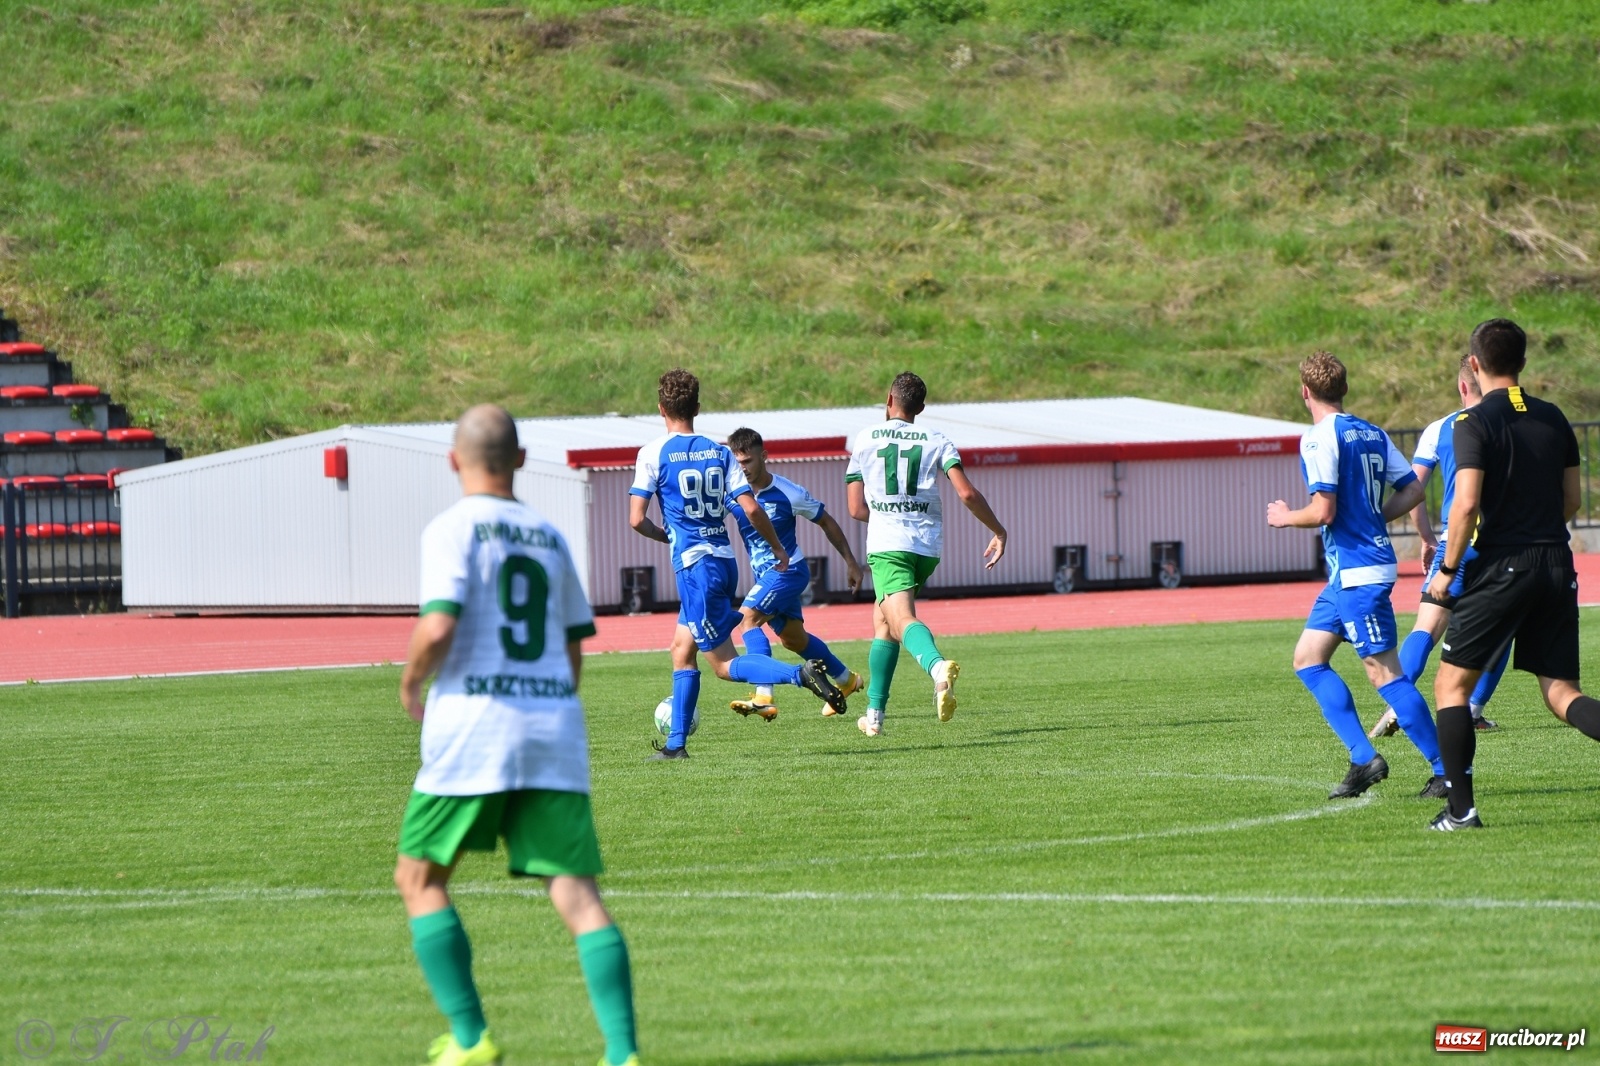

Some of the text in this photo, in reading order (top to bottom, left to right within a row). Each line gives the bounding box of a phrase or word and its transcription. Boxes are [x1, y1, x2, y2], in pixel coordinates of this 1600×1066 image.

[668, 451, 688, 462] UNIA
[871, 429, 928, 441] GWIAZDA
[678, 467, 725, 518] 99
[876, 443, 923, 496] 11
[1361, 453, 1383, 514] 16
[497, 555, 548, 662] 9
